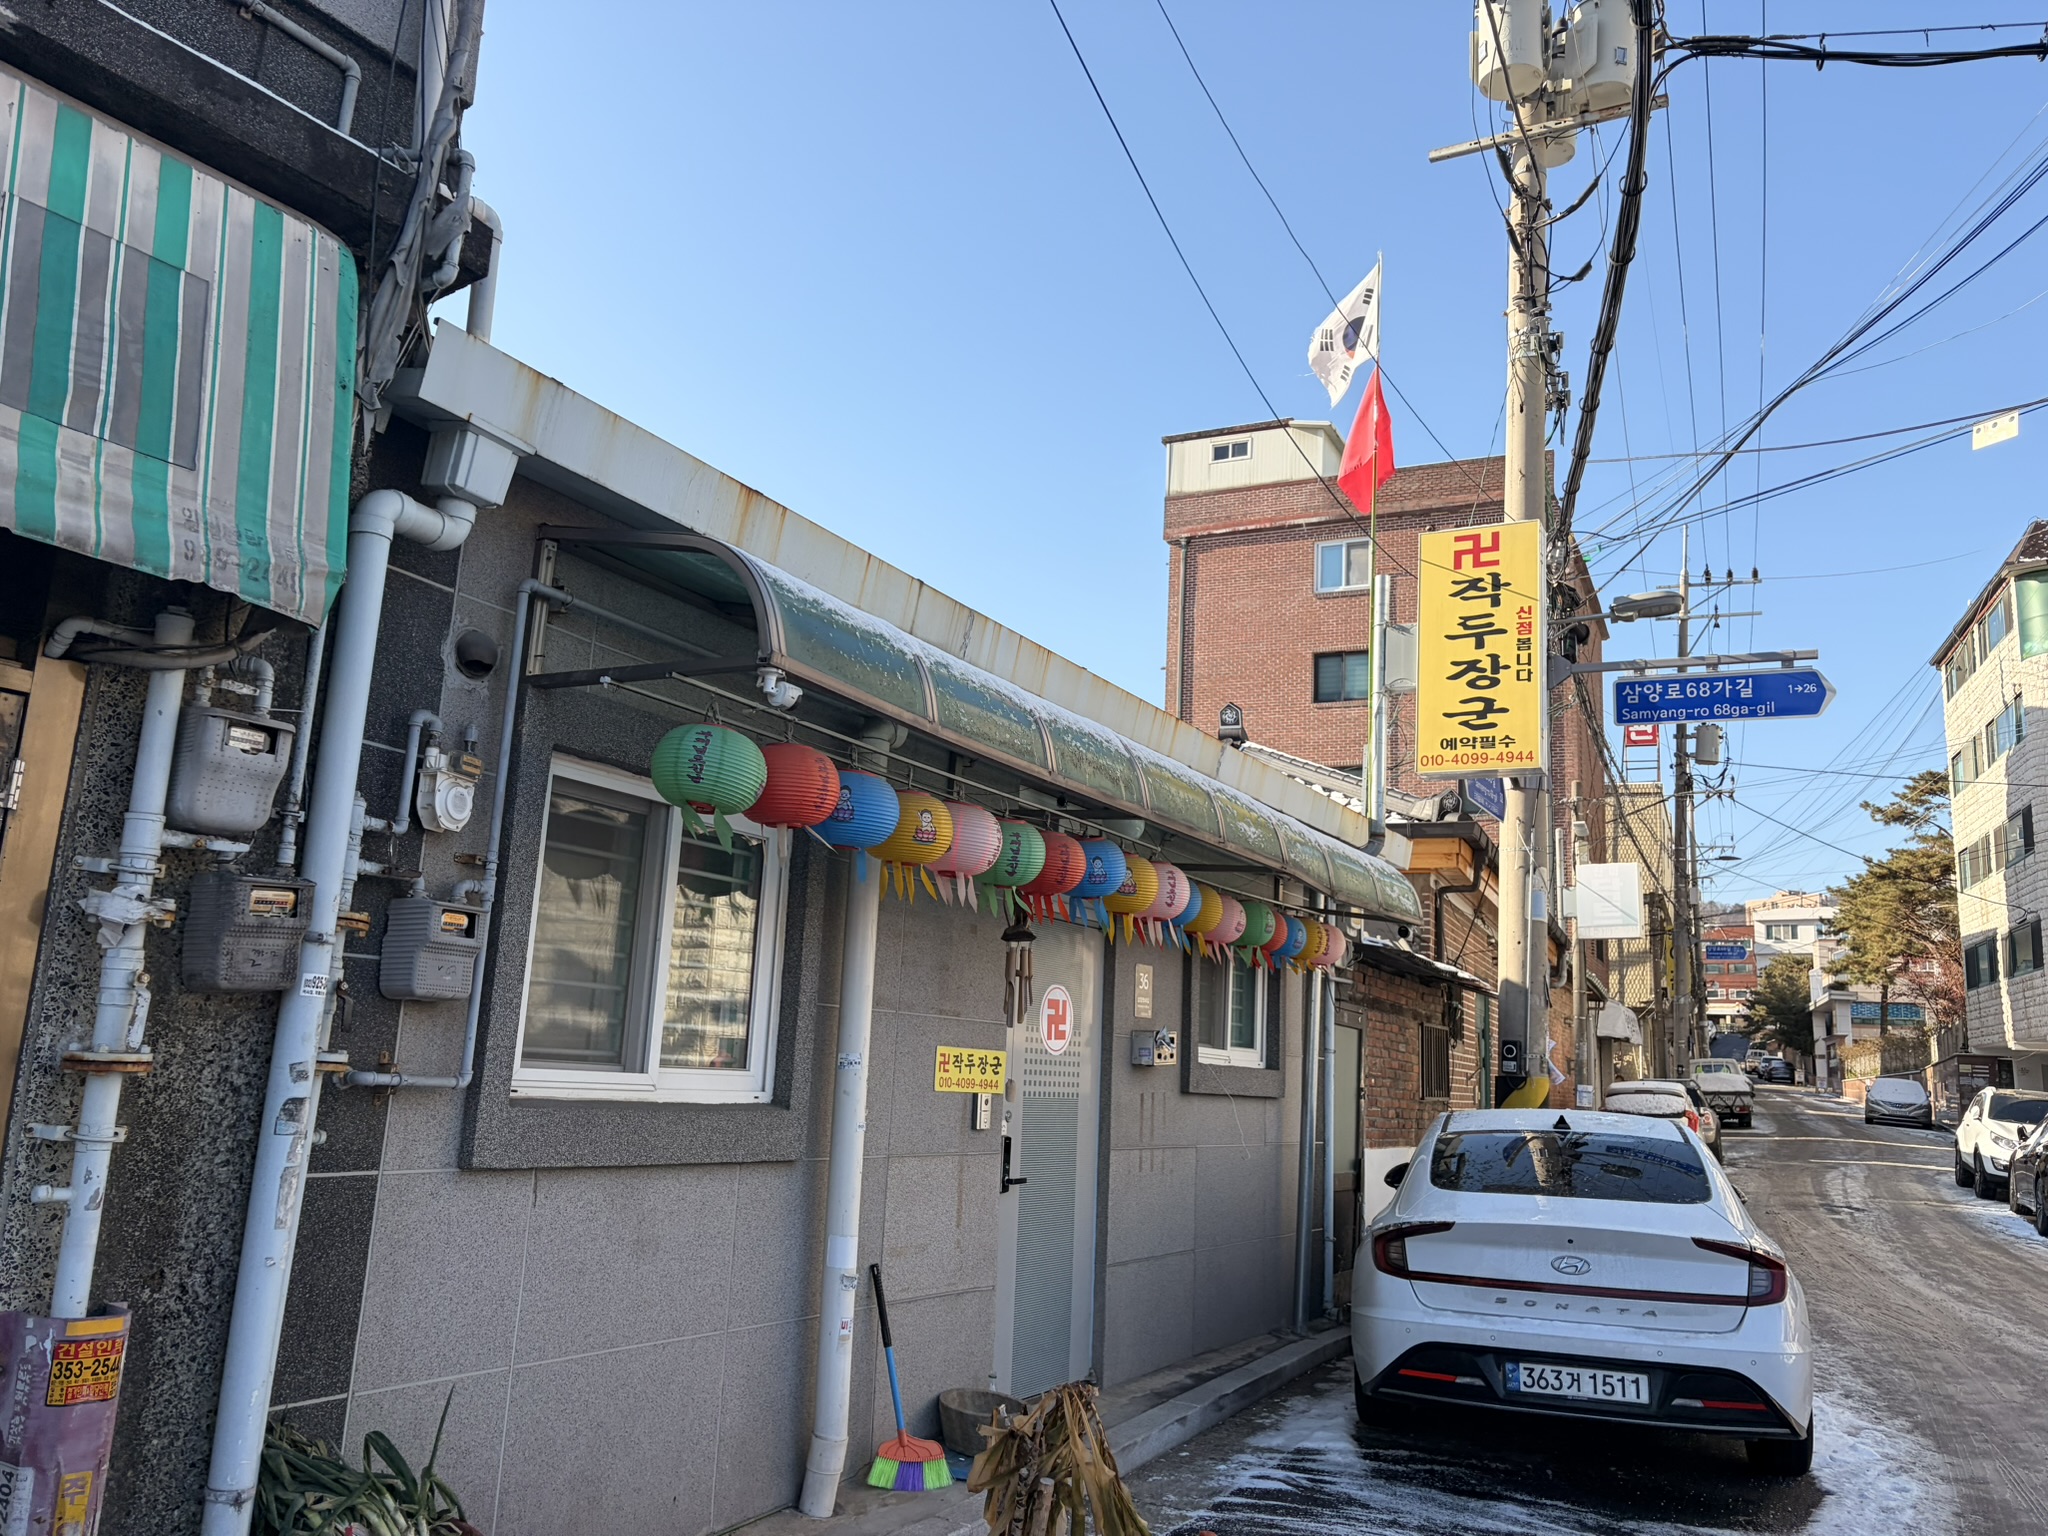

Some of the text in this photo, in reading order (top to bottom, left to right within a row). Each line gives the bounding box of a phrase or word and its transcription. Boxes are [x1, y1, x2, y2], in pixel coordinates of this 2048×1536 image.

[1442, 572, 1512, 731] 작두장군
[1622, 677, 1753, 704] 삼양로68가길
[1622, 701, 1775, 722] Samyang-ro 68ga-gil
[1440, 735, 1517, 751] 예약필수
[1420, 750, 1535, 767] 010-4099-4944
[1139, 973, 1149, 990] 36
[952, 1052, 1002, 1075] 작두장군
[939, 1076, 999, 1090] 010-4099-4944
[1495, 1297, 1657, 1318] SONATA
[1522, 1366, 1640, 1400] 363거 1511
